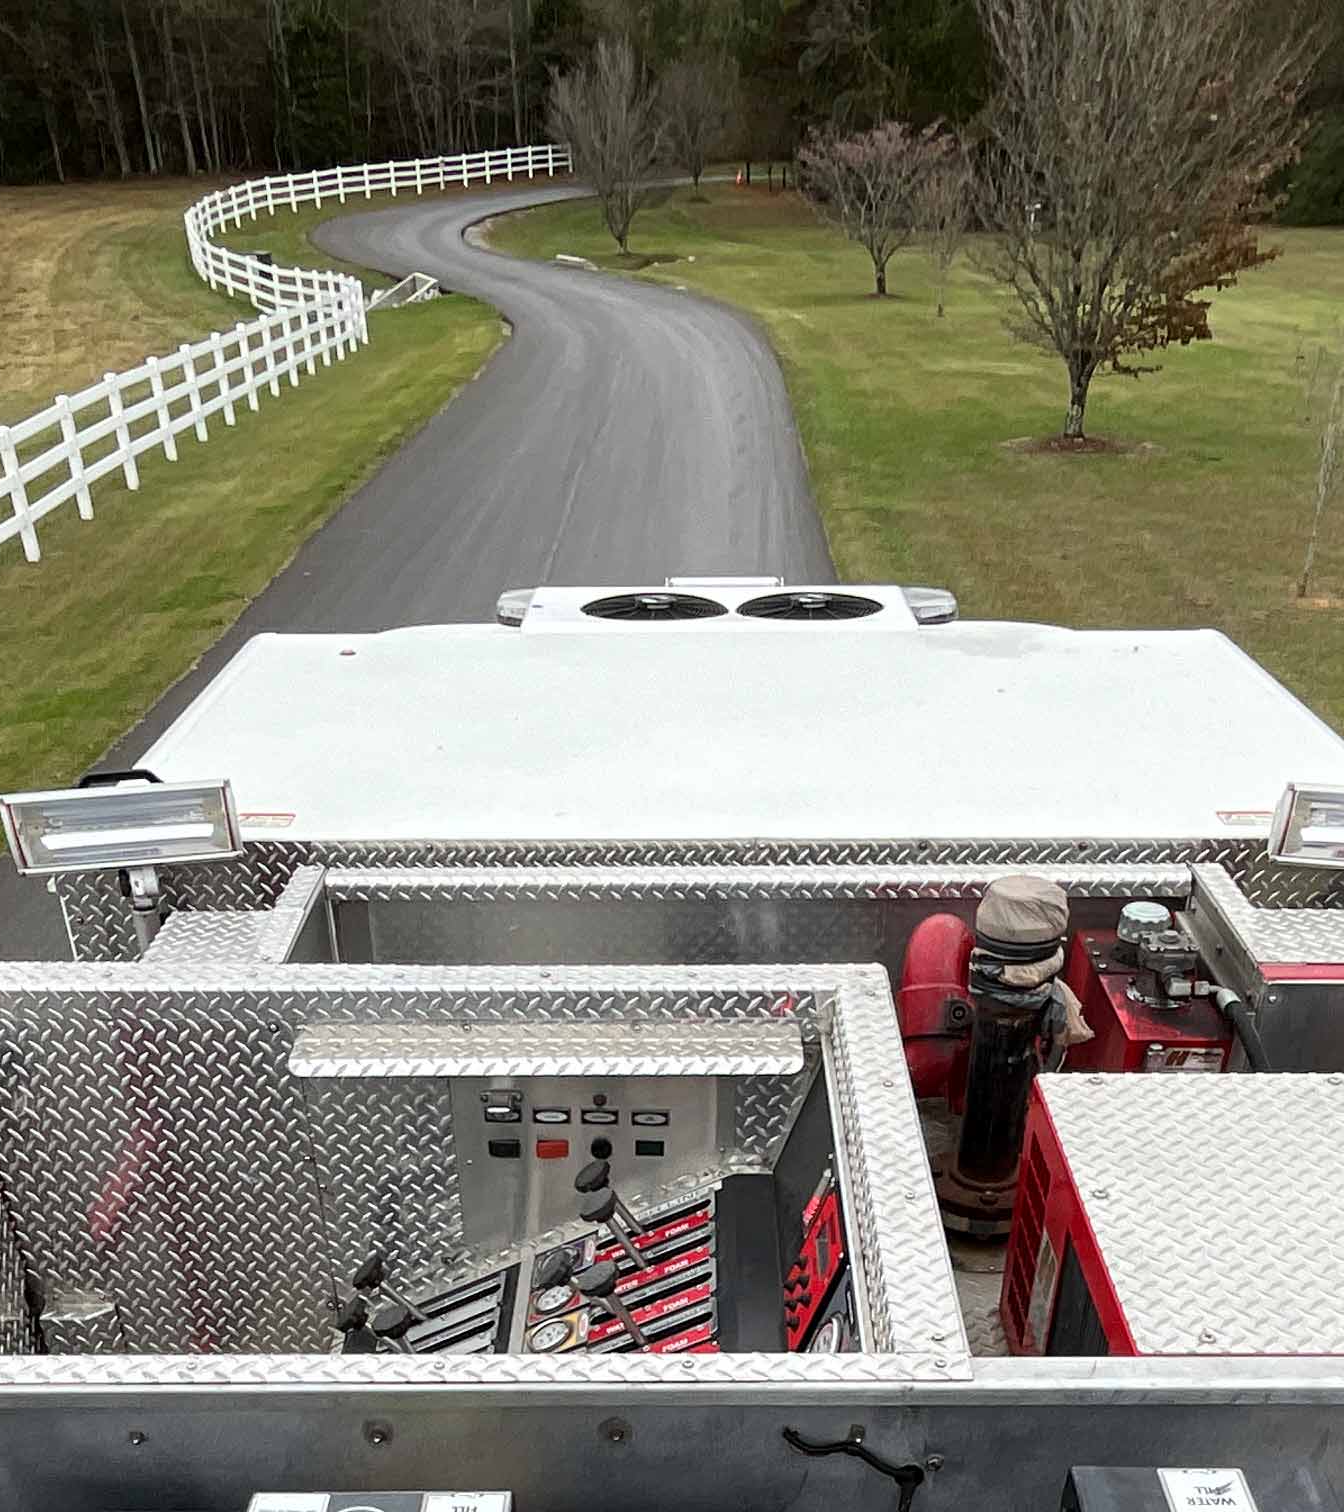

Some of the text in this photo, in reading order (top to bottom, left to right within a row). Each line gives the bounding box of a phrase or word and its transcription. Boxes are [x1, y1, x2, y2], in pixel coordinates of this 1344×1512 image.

[665, 1223, 689, 1238] FOAM
[664, 1260, 689, 1274] FOAM
[663, 1298, 689, 1313] FOAM
[1185, 1496, 1237, 1506] WATER
